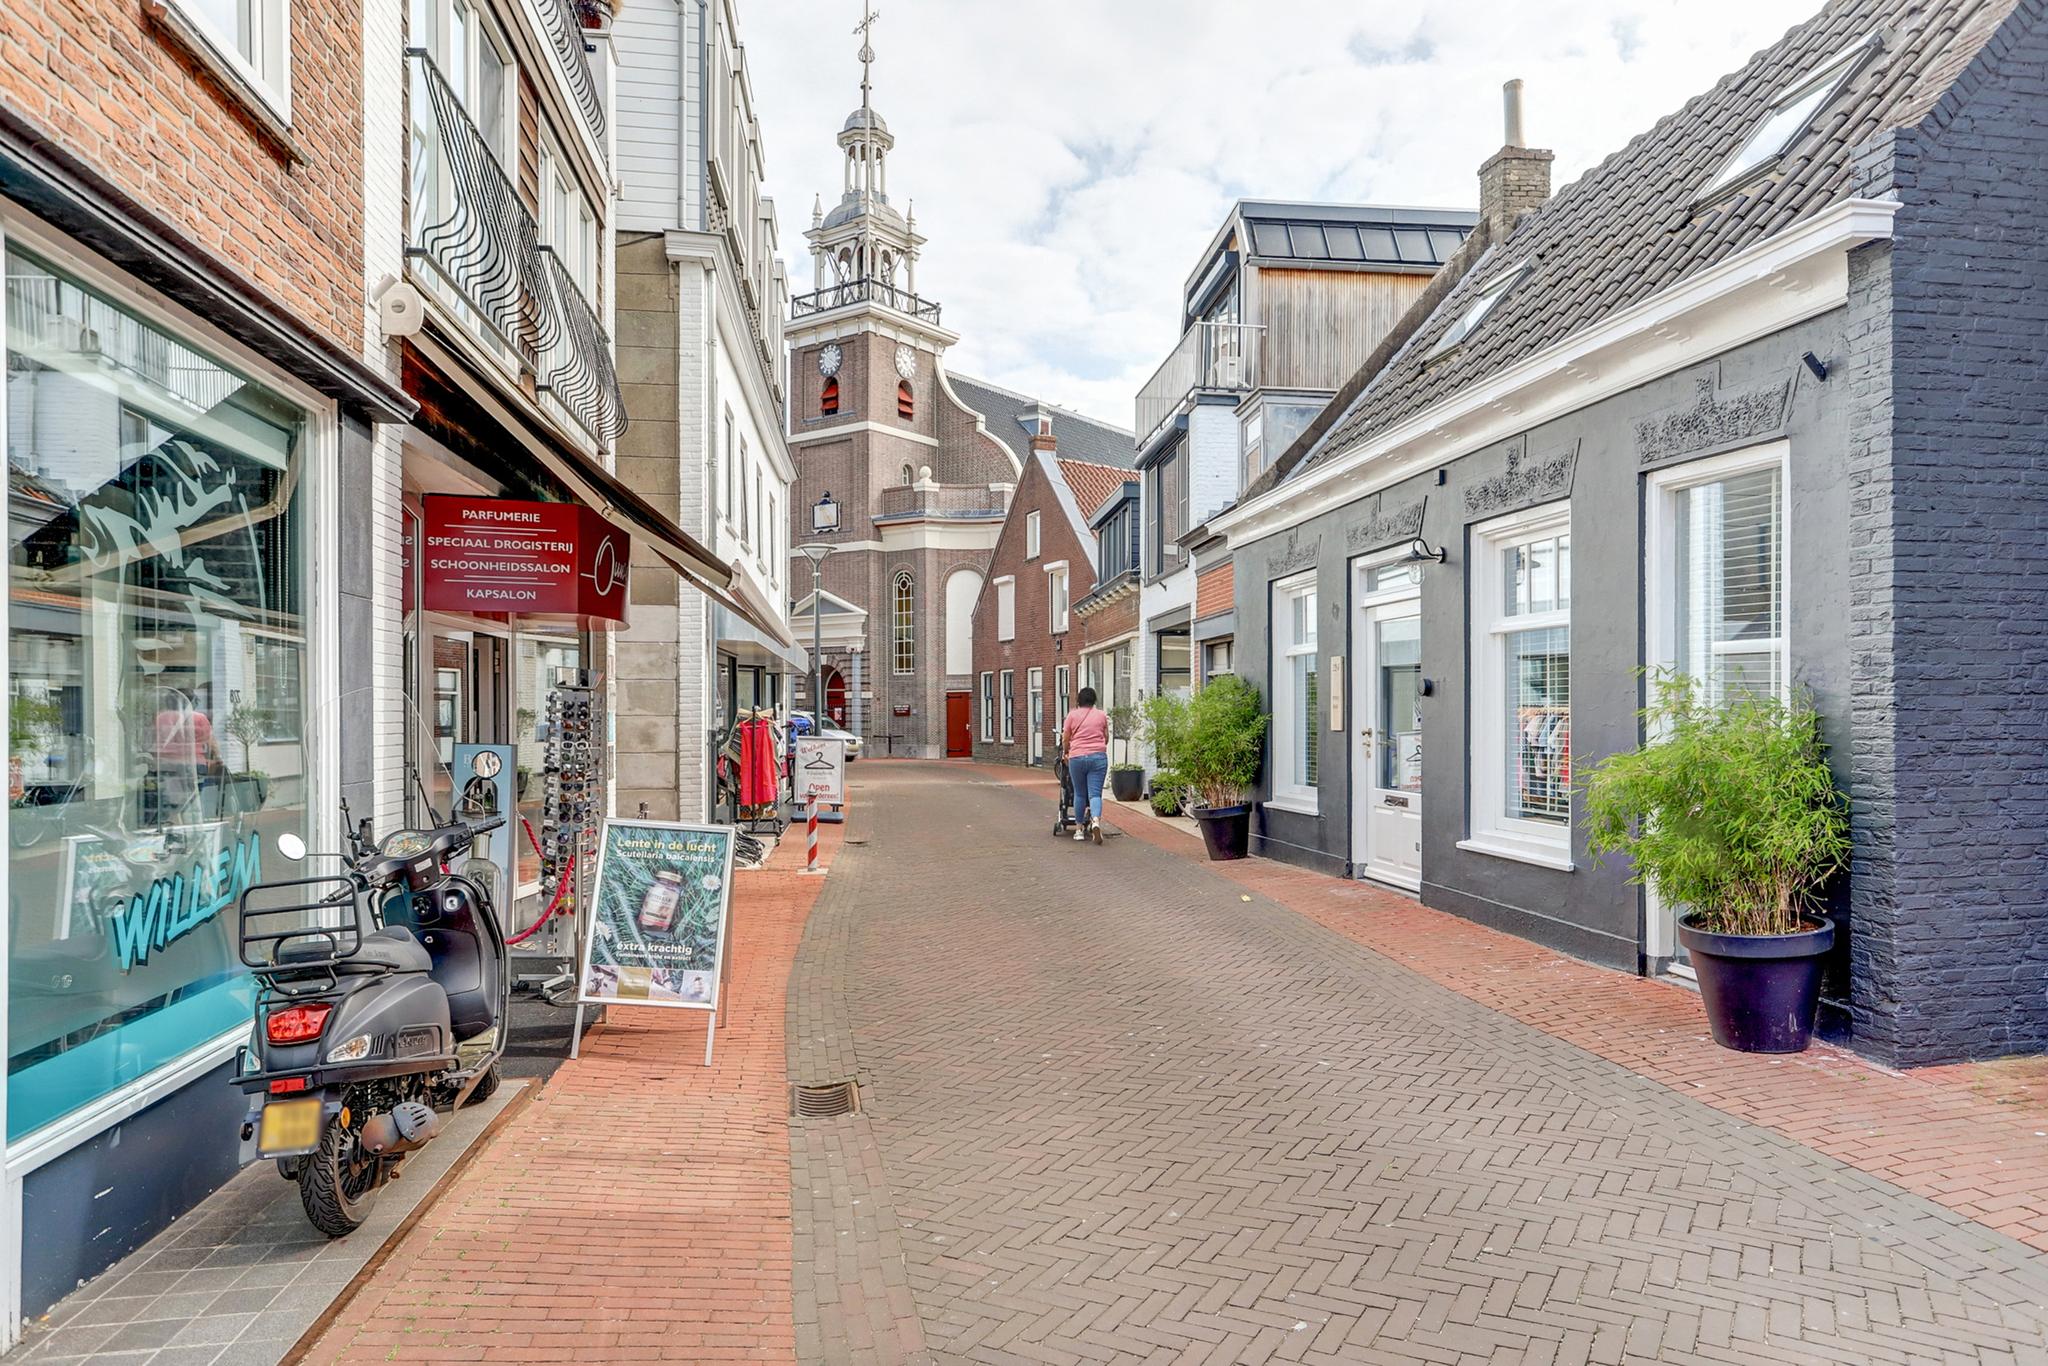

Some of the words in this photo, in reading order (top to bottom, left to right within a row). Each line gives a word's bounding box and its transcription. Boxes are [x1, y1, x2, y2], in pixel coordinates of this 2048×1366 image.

[462, 509, 541, 523] PARFUMERIE
[427, 536, 491, 549] SPECIAAL
[494, 539, 574, 554] DROGISTERIJ
[430, 558, 571, 574] SCHOONHEIDSSALON
[466, 588, 537, 600] KAPSALON
[617, 837, 651, 849] Lente
[654, 839, 665, 849] in
[668, 841, 684, 851] de
[686, 842, 717, 853] lucht
[616, 849, 664, 859] Scutellaria
[112, 830, 262, 976] WILLEM
[647, 942, 693, 956] krachtig
